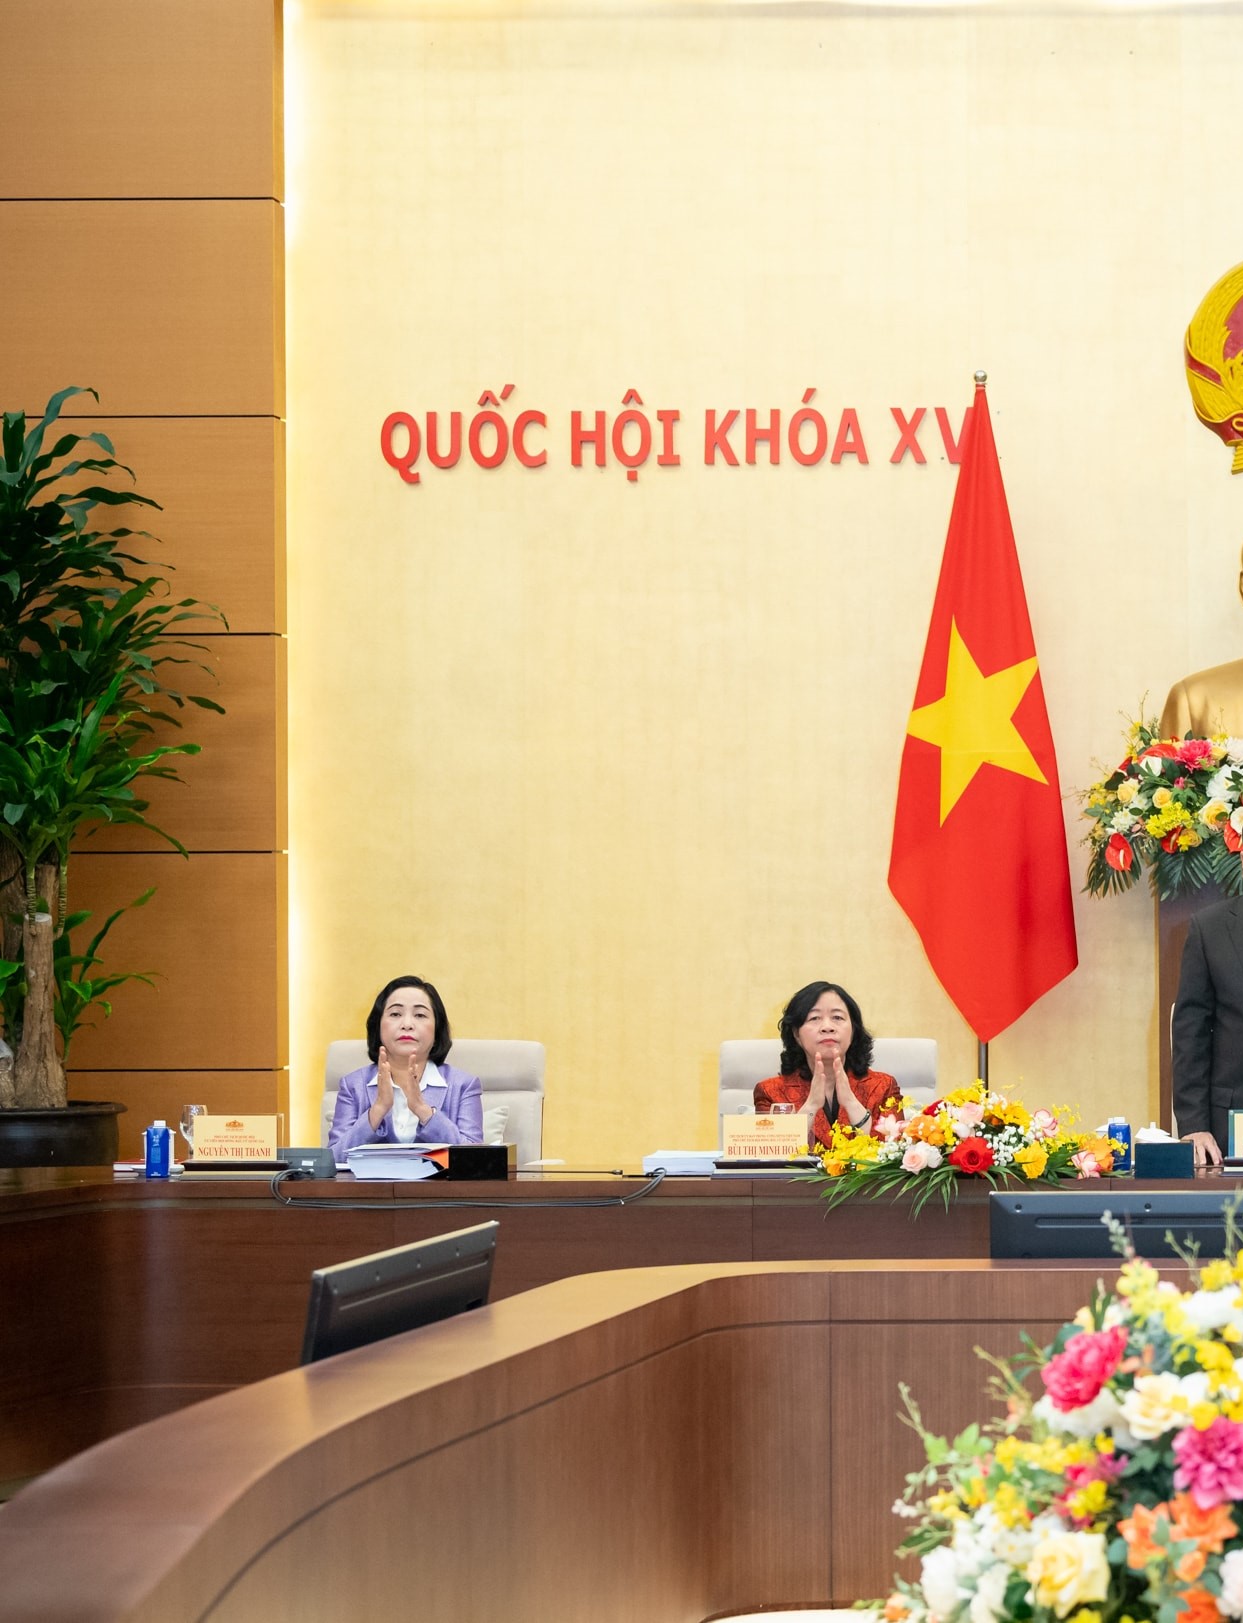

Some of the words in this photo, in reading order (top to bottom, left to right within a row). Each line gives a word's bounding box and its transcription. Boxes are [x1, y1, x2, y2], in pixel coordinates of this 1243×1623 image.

[381, 384, 547, 483] QUỐC
[571, 389, 680, 481] HỘI
[704, 388, 868, 466] KHÓA
[231, 1147, 244, 1158] THỊ
[245, 1147, 271, 1157] THANH
[728, 1143, 741, 1156] BÙI
[743, 1145, 757, 1158] THỊ
[759, 1145, 780, 1156] MINH
